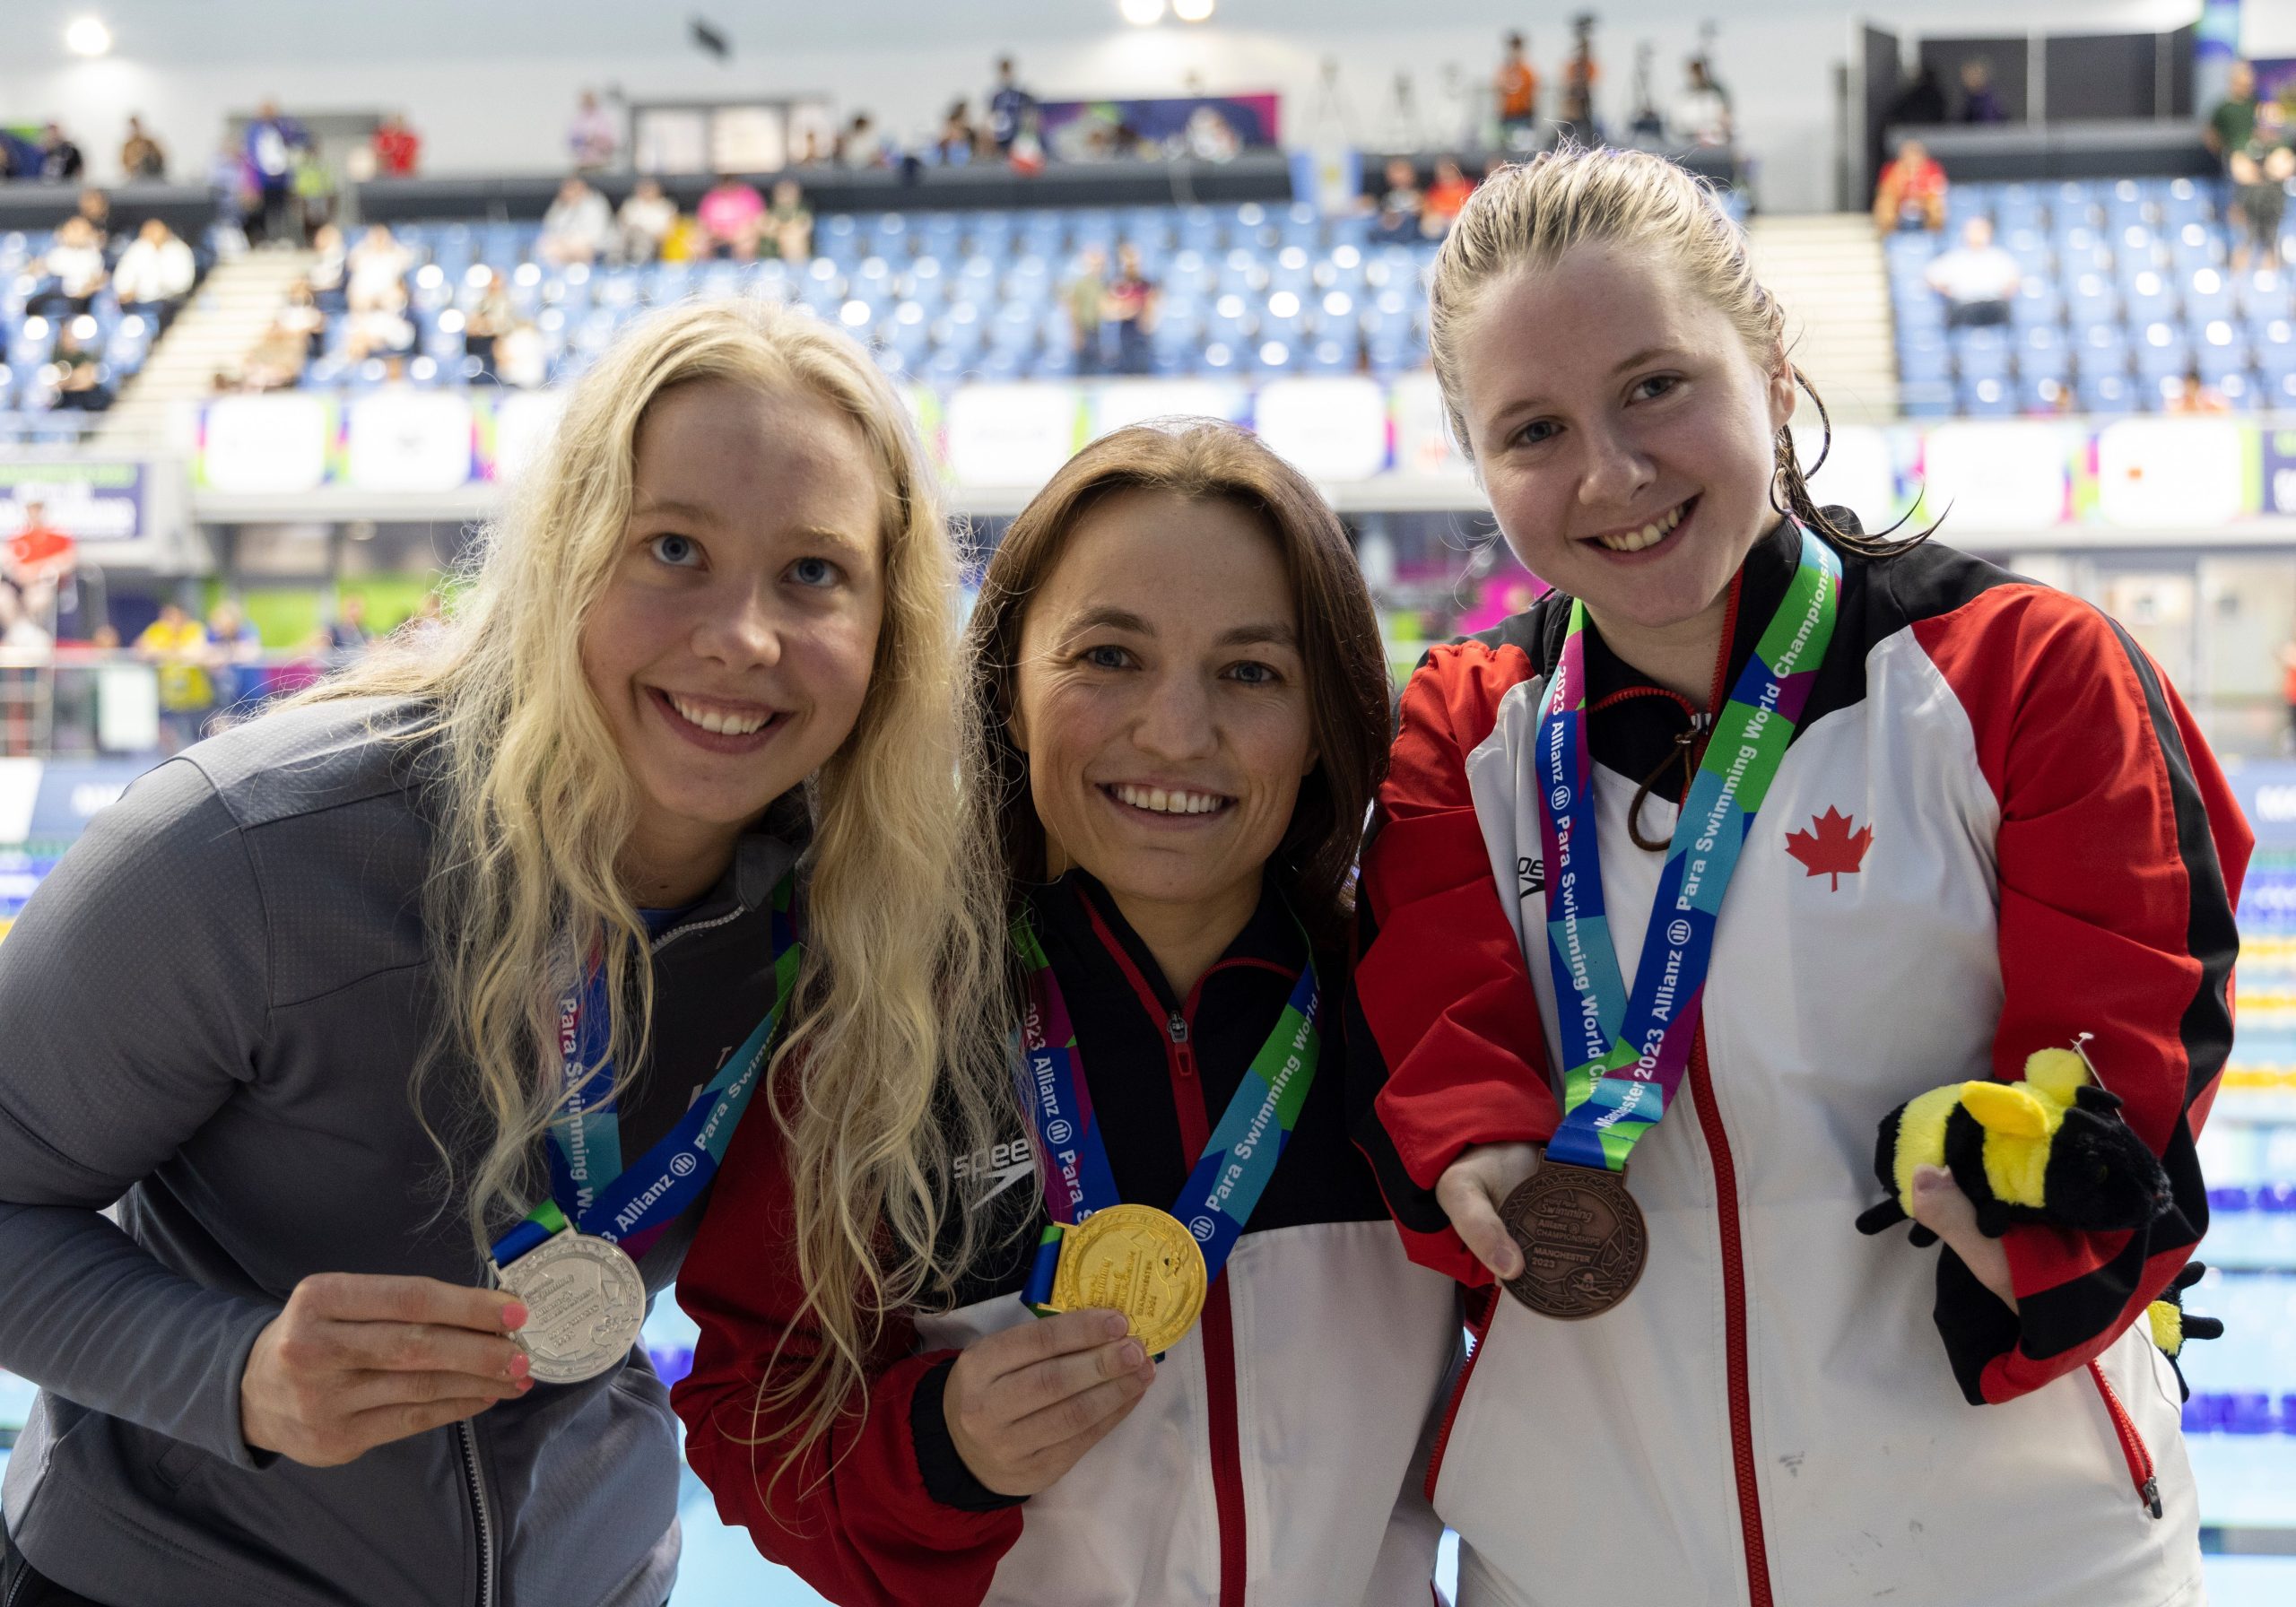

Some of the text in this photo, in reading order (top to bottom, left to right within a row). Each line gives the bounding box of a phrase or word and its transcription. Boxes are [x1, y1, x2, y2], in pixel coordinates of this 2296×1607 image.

[1552, 665, 1567, 716] 2023
[1551, 720, 1565, 785] Allianz
[1557, 814, 1570, 868] Para
[1634, 1028, 1665, 1080] 2023
[1651, 949, 1683, 1022] Allianz
[1675, 858, 1706, 911] Para
[1695, 744, 1758, 853] Swimming
[1742, 682, 1782, 740] World
[1561, 872, 1590, 991] Swimming
[561, 998, 577, 1054] Para
[1580, 995, 1605, 1059] World
[1033, 1055, 1059, 1118] Allianz
[1058, 1149, 1083, 1203] Para
[1205, 995, 1318, 1212] Para Swimming World
[614, 1174, 674, 1232] Allianz
[693, 1102, 728, 1151] Para
[1540, 1203, 1593, 1224] Swimming
[1531, 1256, 1555, 1269] 2023
[1534, 1247, 1592, 1264] MANCHESTER
